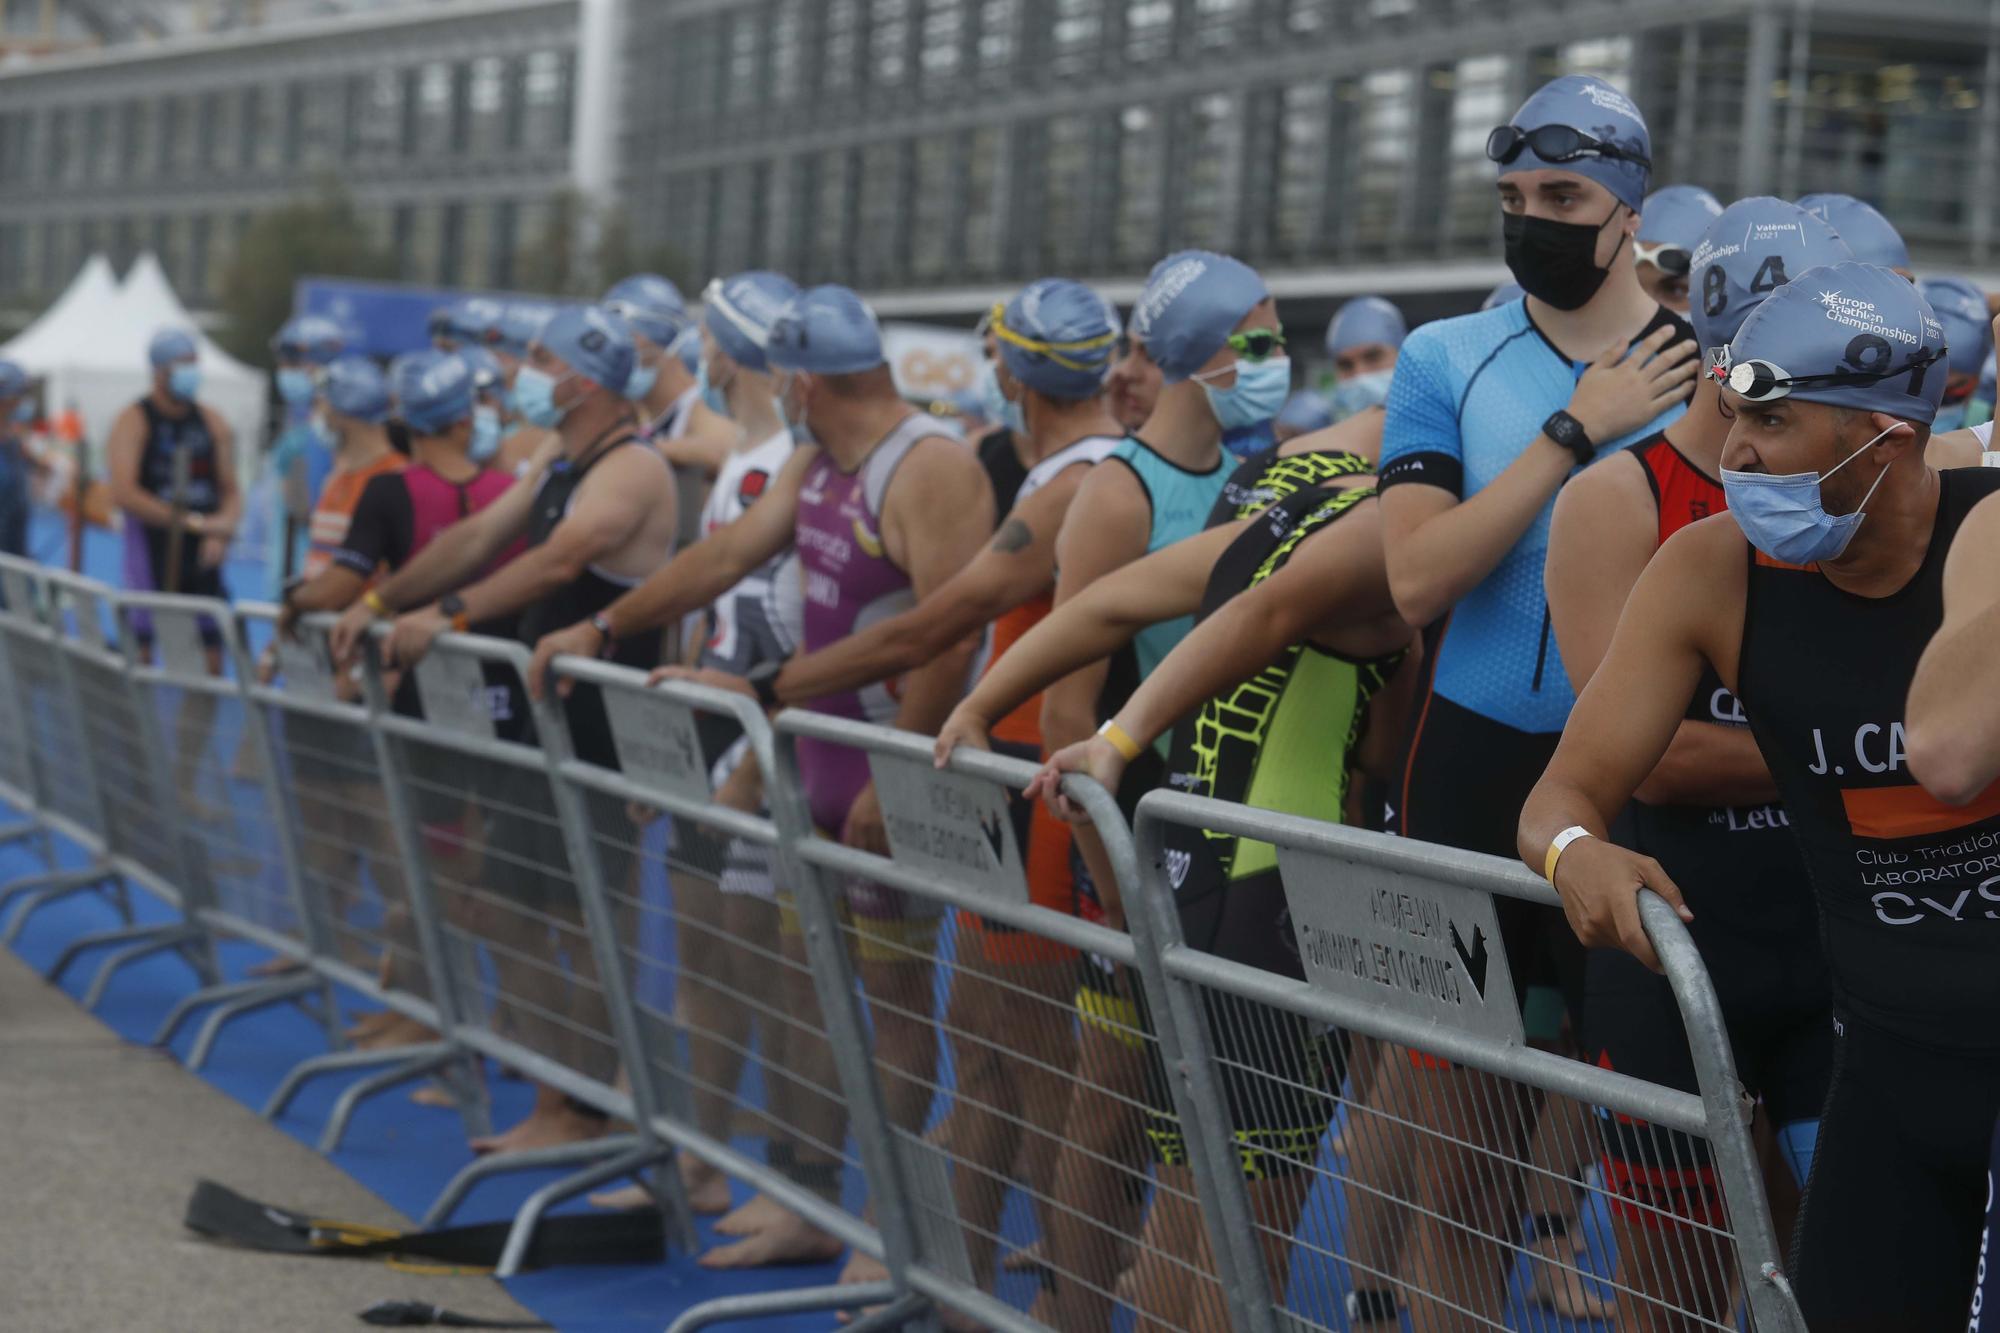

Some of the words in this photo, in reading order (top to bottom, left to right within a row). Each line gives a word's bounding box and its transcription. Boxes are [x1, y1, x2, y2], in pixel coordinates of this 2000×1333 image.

[1753, 231, 1778, 240] 2021
[1830, 294, 1875, 311] Europe
[1829, 303, 1884, 323] Triathlon
[1826, 309, 1917, 344] Championships
[1808, 728, 1844, 776] J.
[1856, 849, 1909, 865] Club
